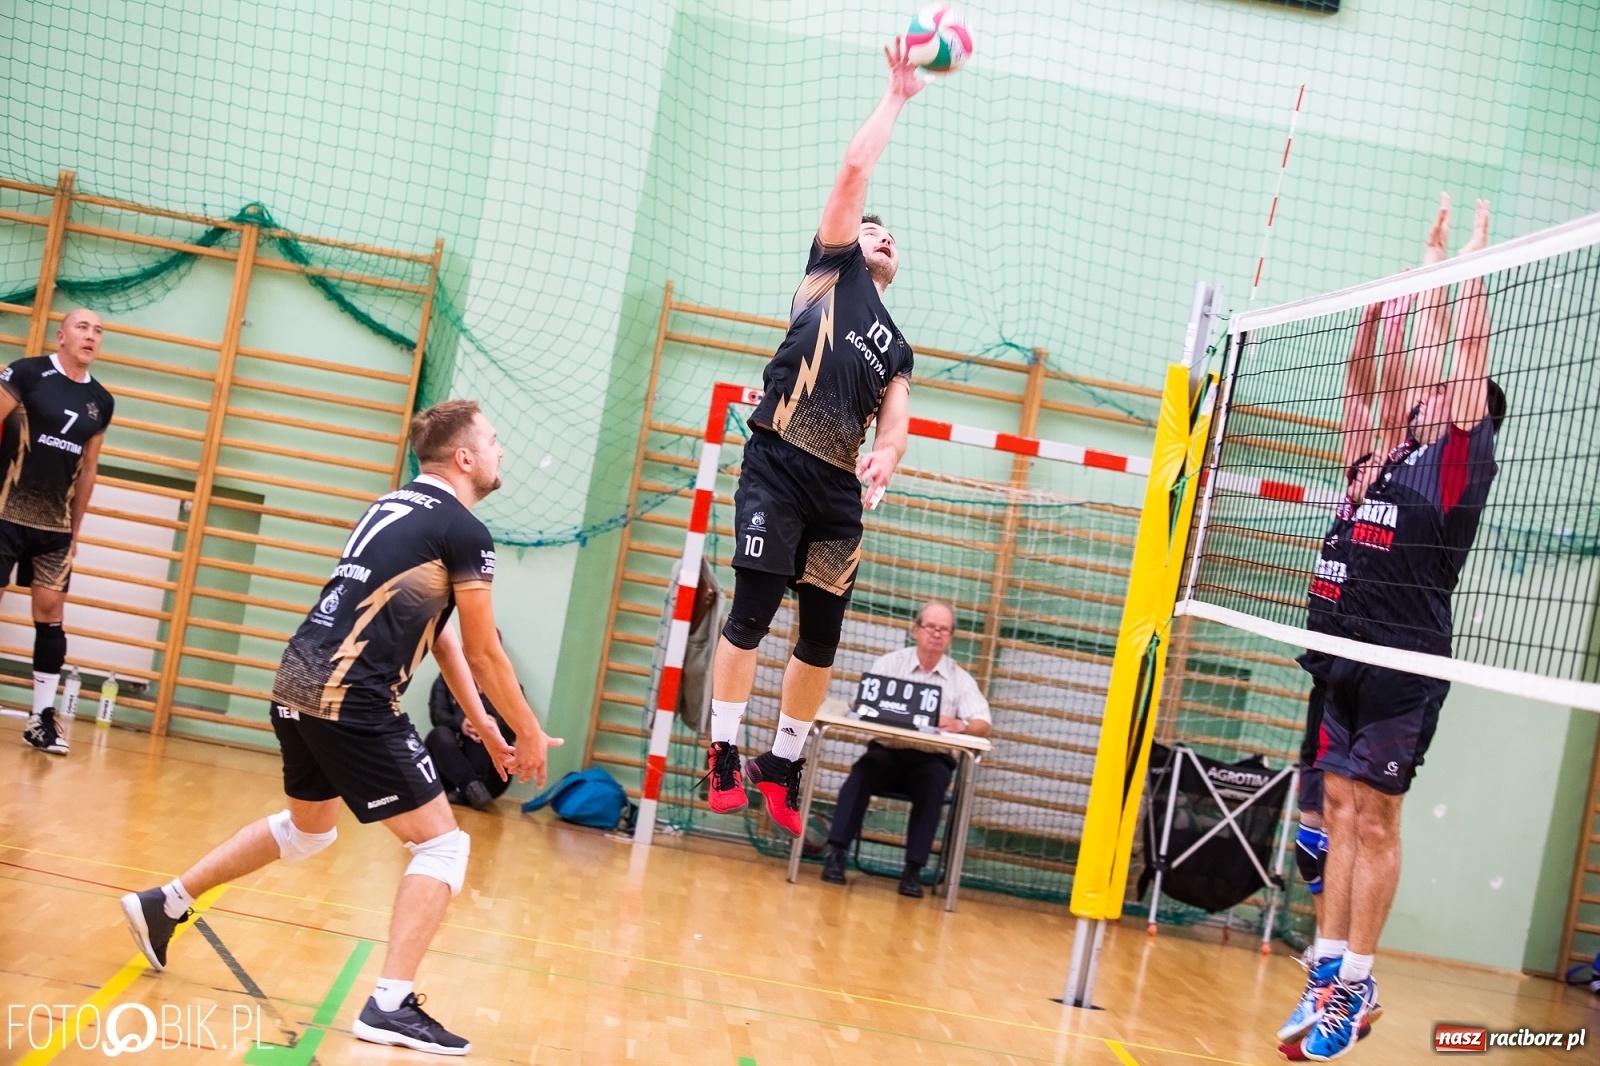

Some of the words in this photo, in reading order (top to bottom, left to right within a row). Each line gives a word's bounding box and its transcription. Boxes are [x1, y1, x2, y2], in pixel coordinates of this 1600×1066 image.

[867, 313, 893, 354] 10
[60, 409, 79, 434] 7
[37, 433, 83, 455] AGROTIM
[341, 502, 414, 559] 17
[744, 534, 764, 558] 10
[860, 677, 881, 702] 13
[886, 680, 897, 697] 0
[902, 683, 914, 700] 0
[919, 688, 940, 713] 16
[416, 755, 437, 783] 17
